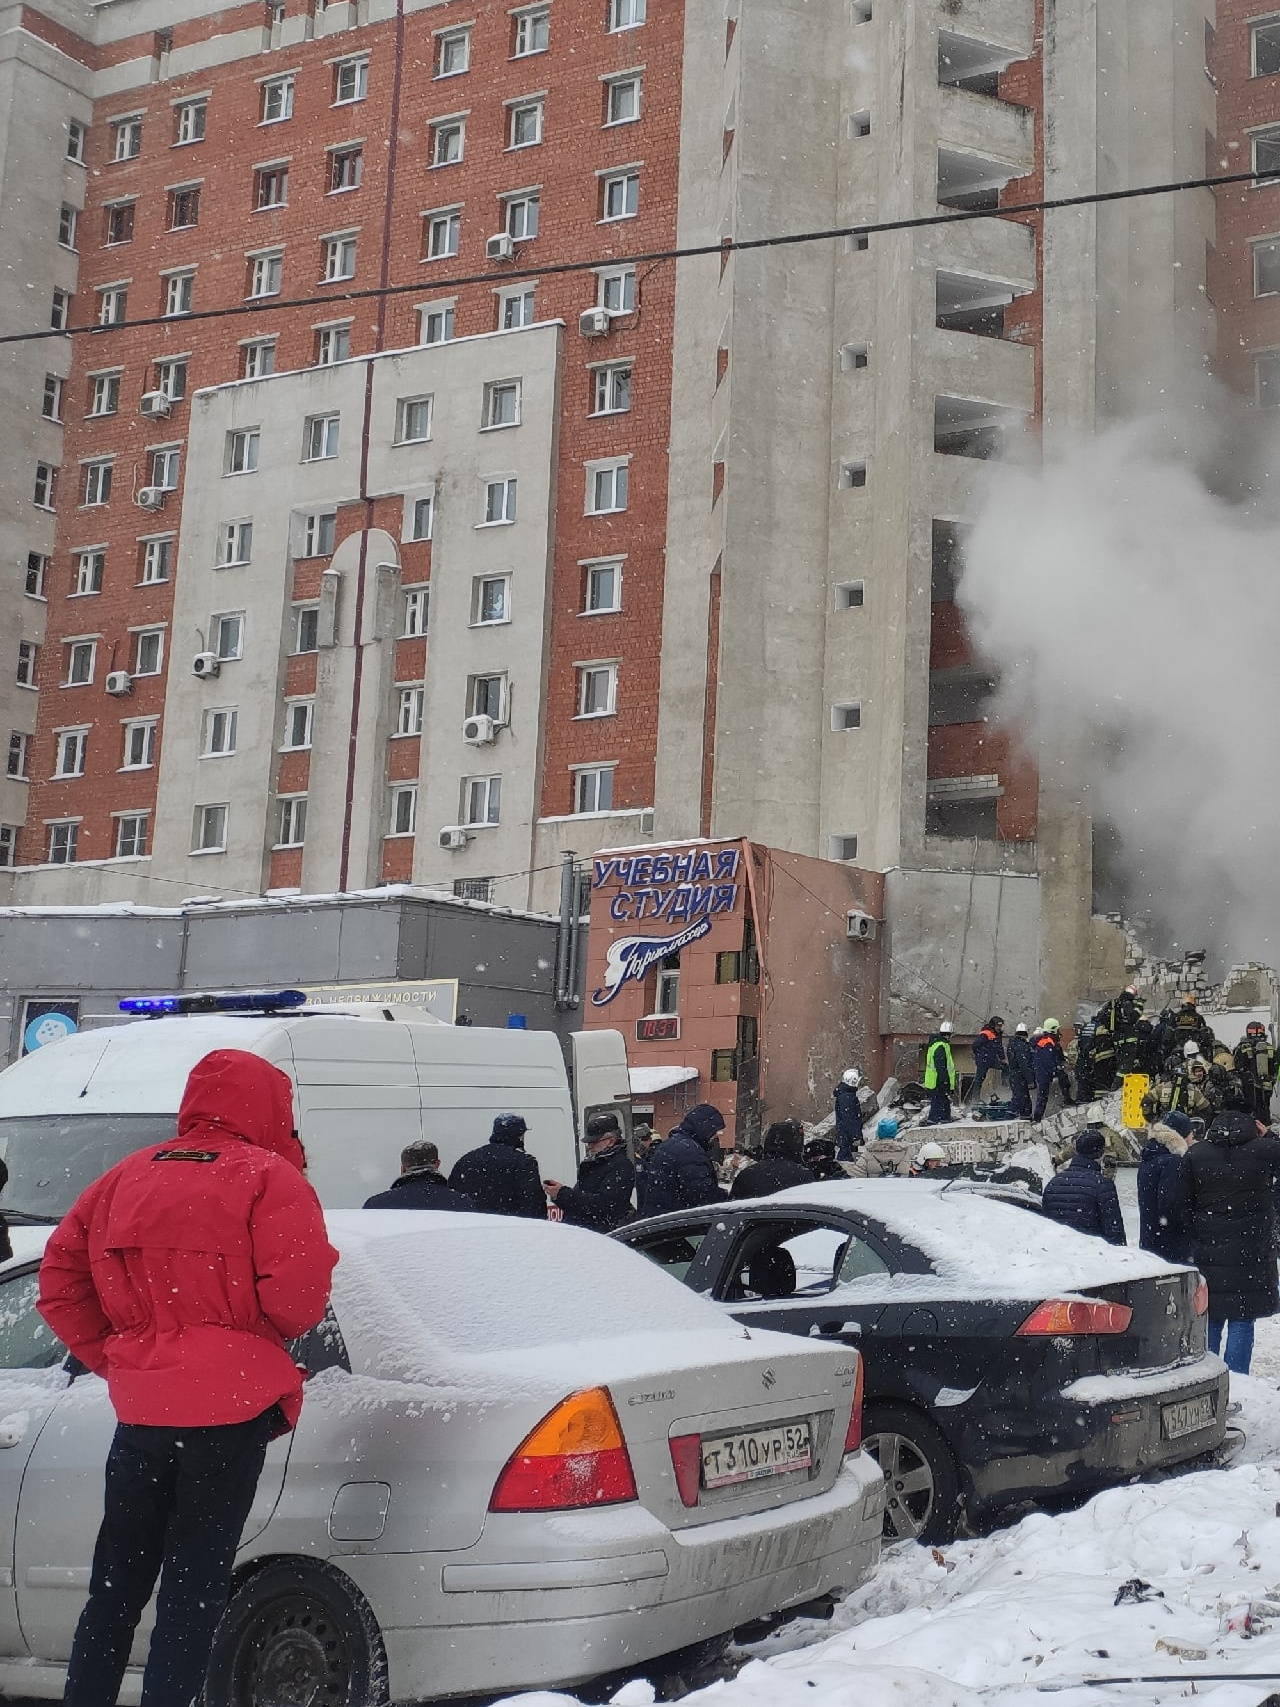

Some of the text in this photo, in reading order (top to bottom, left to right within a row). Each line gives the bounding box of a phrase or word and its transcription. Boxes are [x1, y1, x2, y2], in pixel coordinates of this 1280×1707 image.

[592, 849, 739, 888] УЧЕБНАЯ
[610, 884, 737, 924] СТУДИЯ
[786, 1427, 804, 1450] 52
